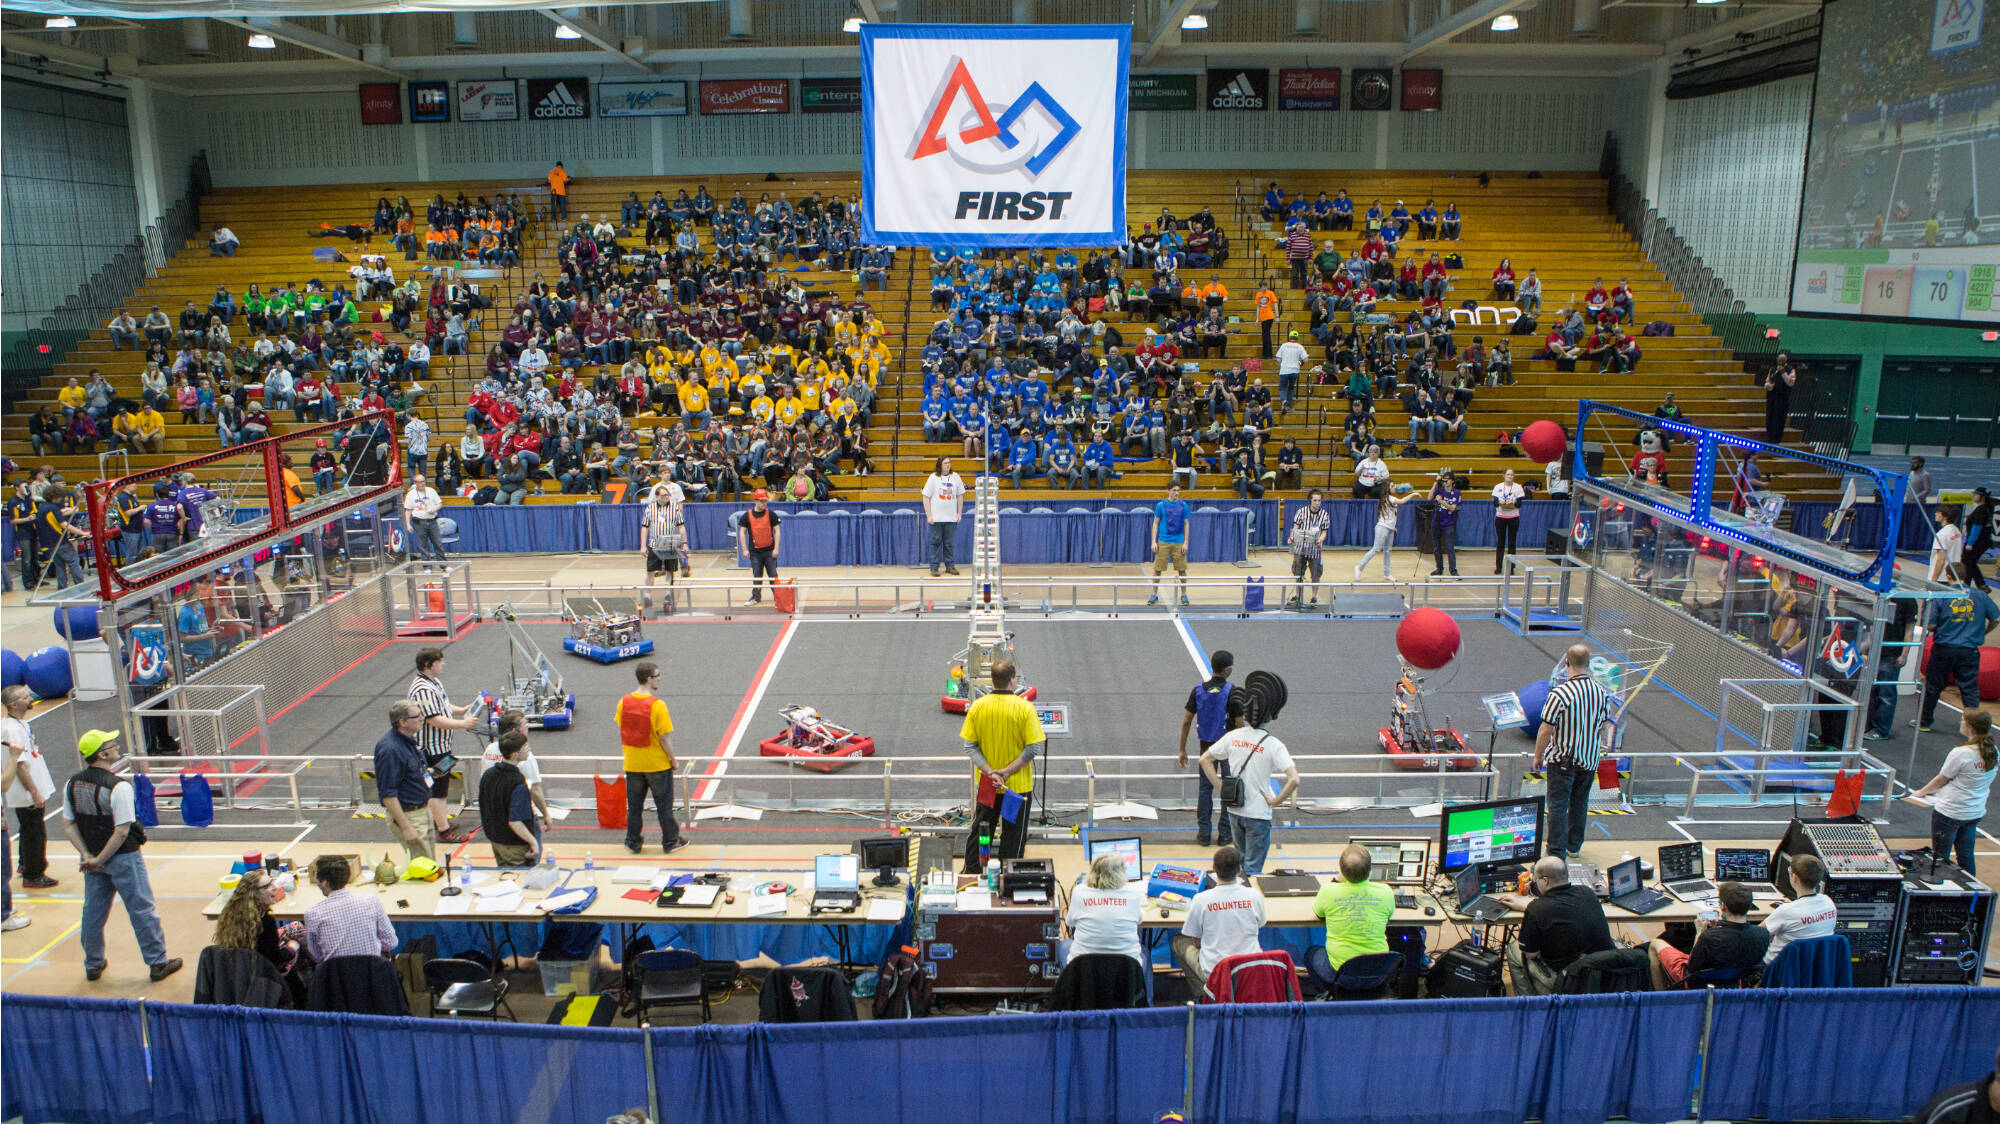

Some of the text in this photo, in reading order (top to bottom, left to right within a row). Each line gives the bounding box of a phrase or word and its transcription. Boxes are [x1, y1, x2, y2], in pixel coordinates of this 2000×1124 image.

[1946, 30, 1970, 43] FIRST
[711, 83, 783, 105] Celebration!
[1407, 86, 1437, 96] xfinity
[366, 99, 393, 110] xfinity
[418, 103, 440, 111] LIVE
[1212, 95, 1263, 108] adidas
[534, 104, 584, 118] adidas
[954, 190, 1073, 221] FIRST
[1972, 267, 1992, 278] 1918
[1878, 280, 1895, 299] 16
[1930, 281, 1948, 302] 70
[1970, 282, 1988, 292] 4237
[618, 645, 640, 657] 4237
[1083, 897, 1127, 907] VOLUNTEER
[1207, 899, 1252, 912] VOLUNTEER
